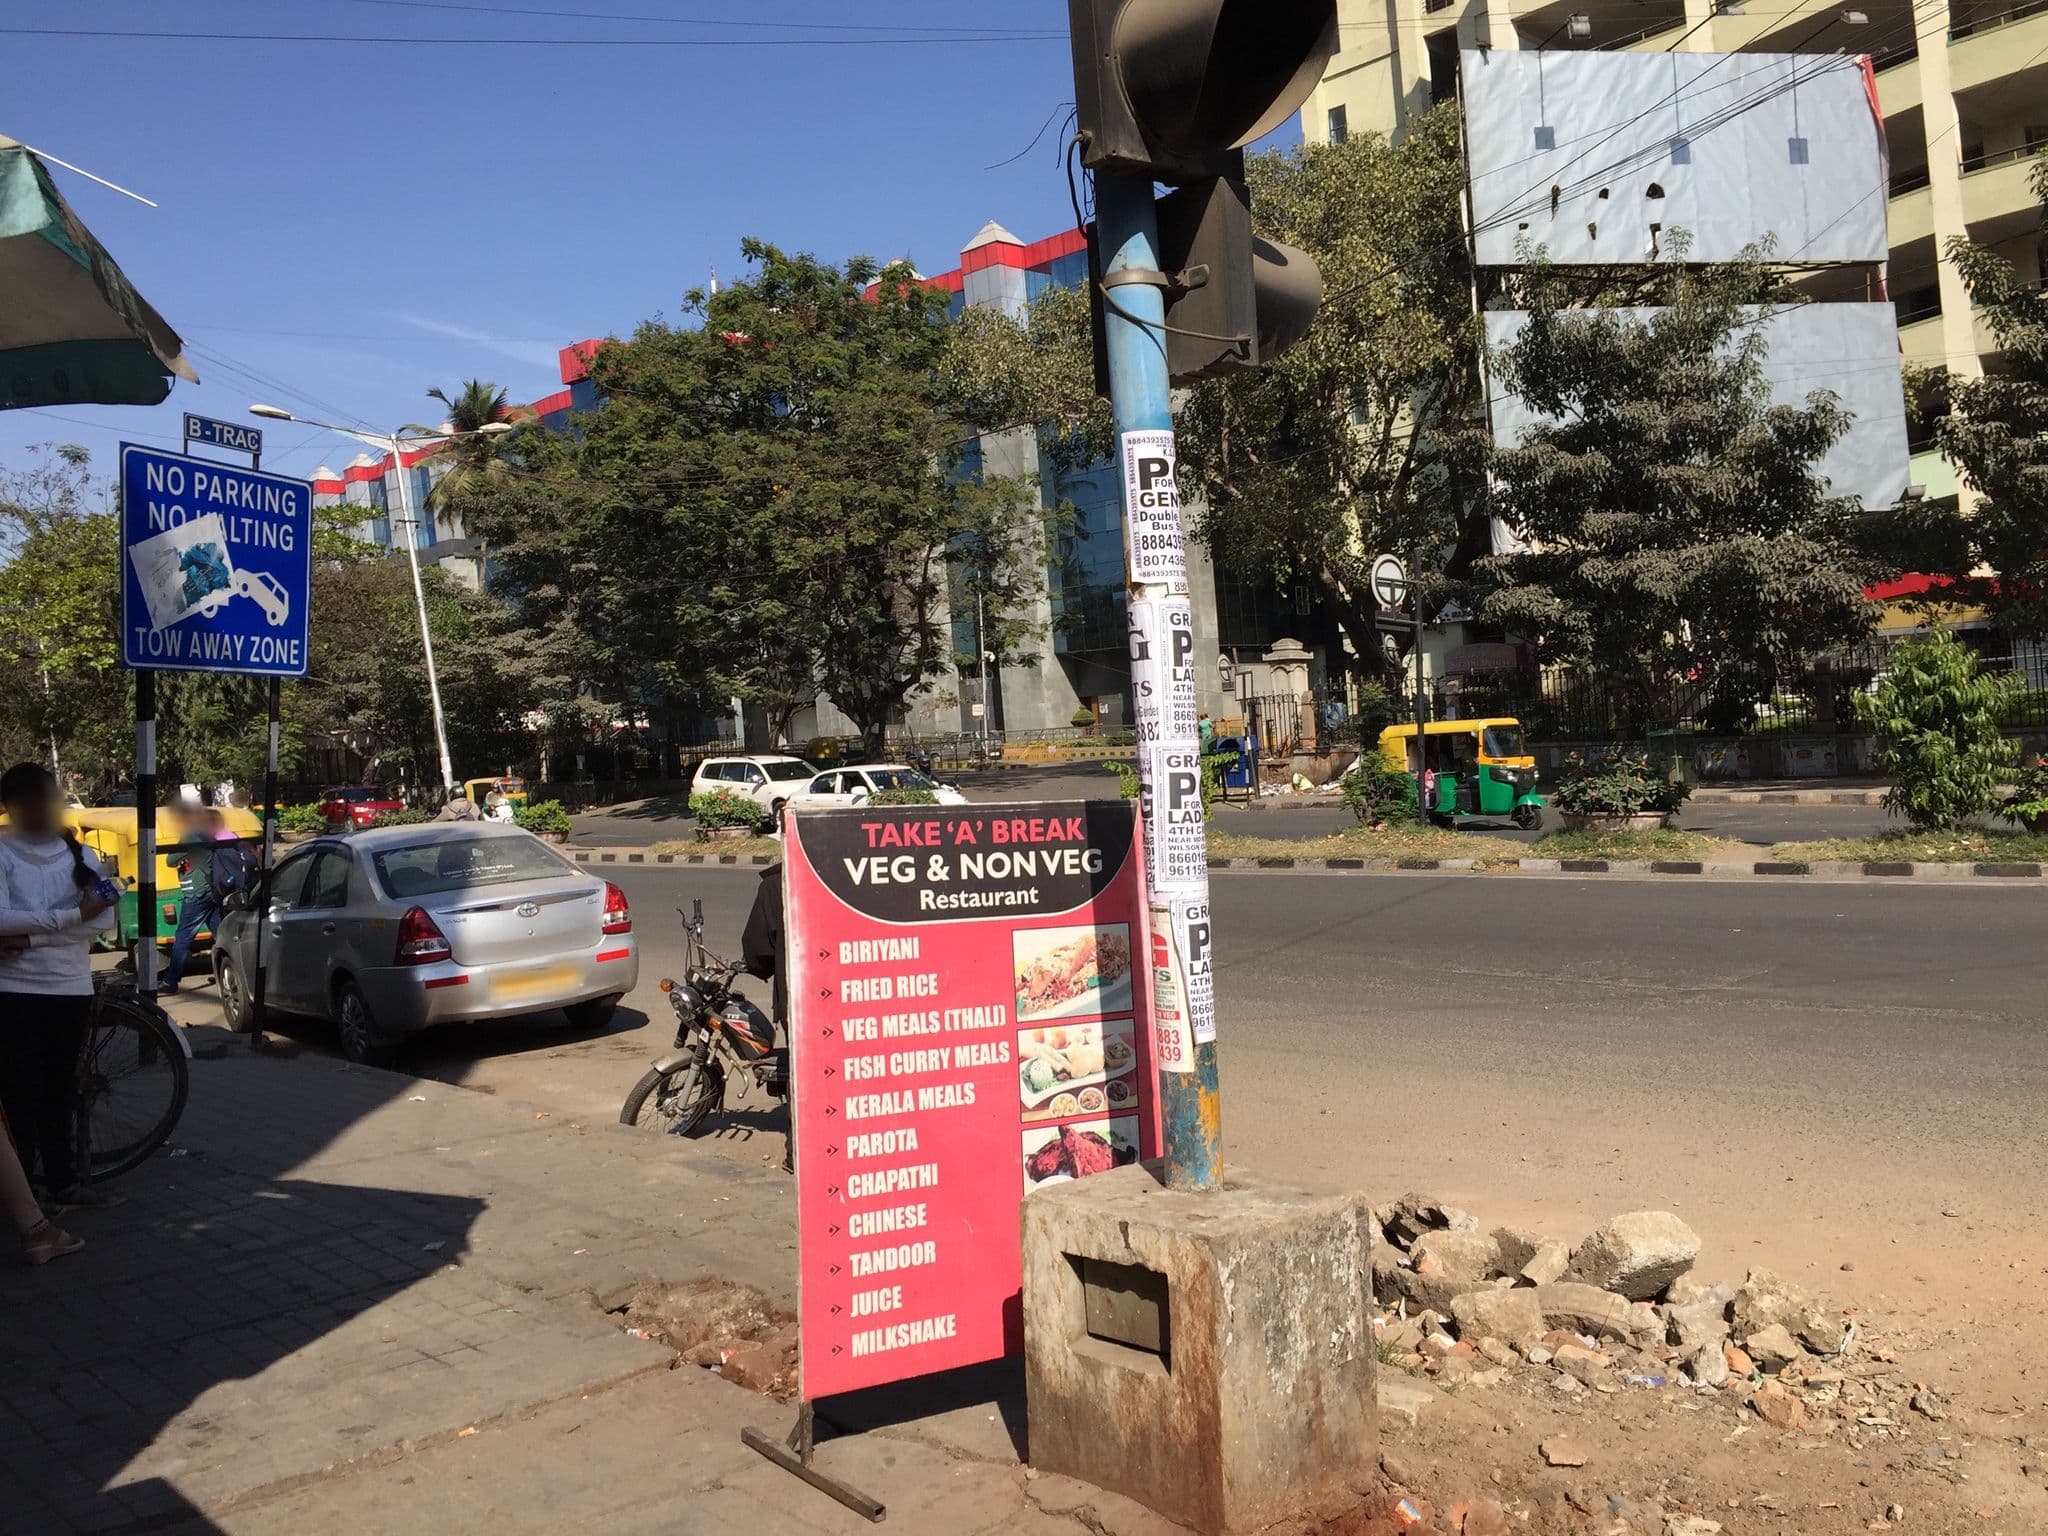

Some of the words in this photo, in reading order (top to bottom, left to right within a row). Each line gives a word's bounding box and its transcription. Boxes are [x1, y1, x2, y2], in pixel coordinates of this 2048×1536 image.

[147, 462, 185, 495] NO
[194, 472, 296, 518] PARKING
[1138, 458, 1177, 491] P
[1154, 478, 1173, 488] FOR
[149, 502, 187, 532] NO
[1140, 510, 1178, 522] Double
[1152, 522, 1174, 531] Bus
[136, 627, 182, 658] TOW
[189, 632, 244, 661] AWAY
[249, 635, 300, 665] ZONE
[861, 821, 944, 849] TAKE
[992, 817, 1084, 844] BREAK
[1169, 827, 1194, 835] 4TH
[844, 855, 917, 886] VEG
[926, 856, 950, 882] &
[960, 851, 1037, 880] NON
[1039, 848, 1103, 877] VEG
[920, 886, 1039, 911] Restaurant
[839, 937, 920, 965] BIRIYANI
[840, 977, 893, 1003] FRIED
[896, 973, 938, 999] RICE
[842, 1017, 878, 1042] VEG
[881, 1010, 941, 1038] MEALS
[944, 1004, 1006, 1033] (THALI)
[843, 1056, 886, 1081] FISH
[890, 1048, 951, 1076] CURRY
[952, 1041, 1010, 1069] MEALS
[845, 1092, 916, 1120] KERALA
[918, 1082, 976, 1112] MEALS
[847, 1128, 918, 1160] PAROTA
[847, 1163, 939, 1199] CHAPATHI
[848, 1203, 927, 1239] CHINESE
[849, 1241, 936, 1277] TANDOOR
[850, 1286, 903, 1318] JUICE
[851, 1314, 957, 1358] MILKSHAKE
